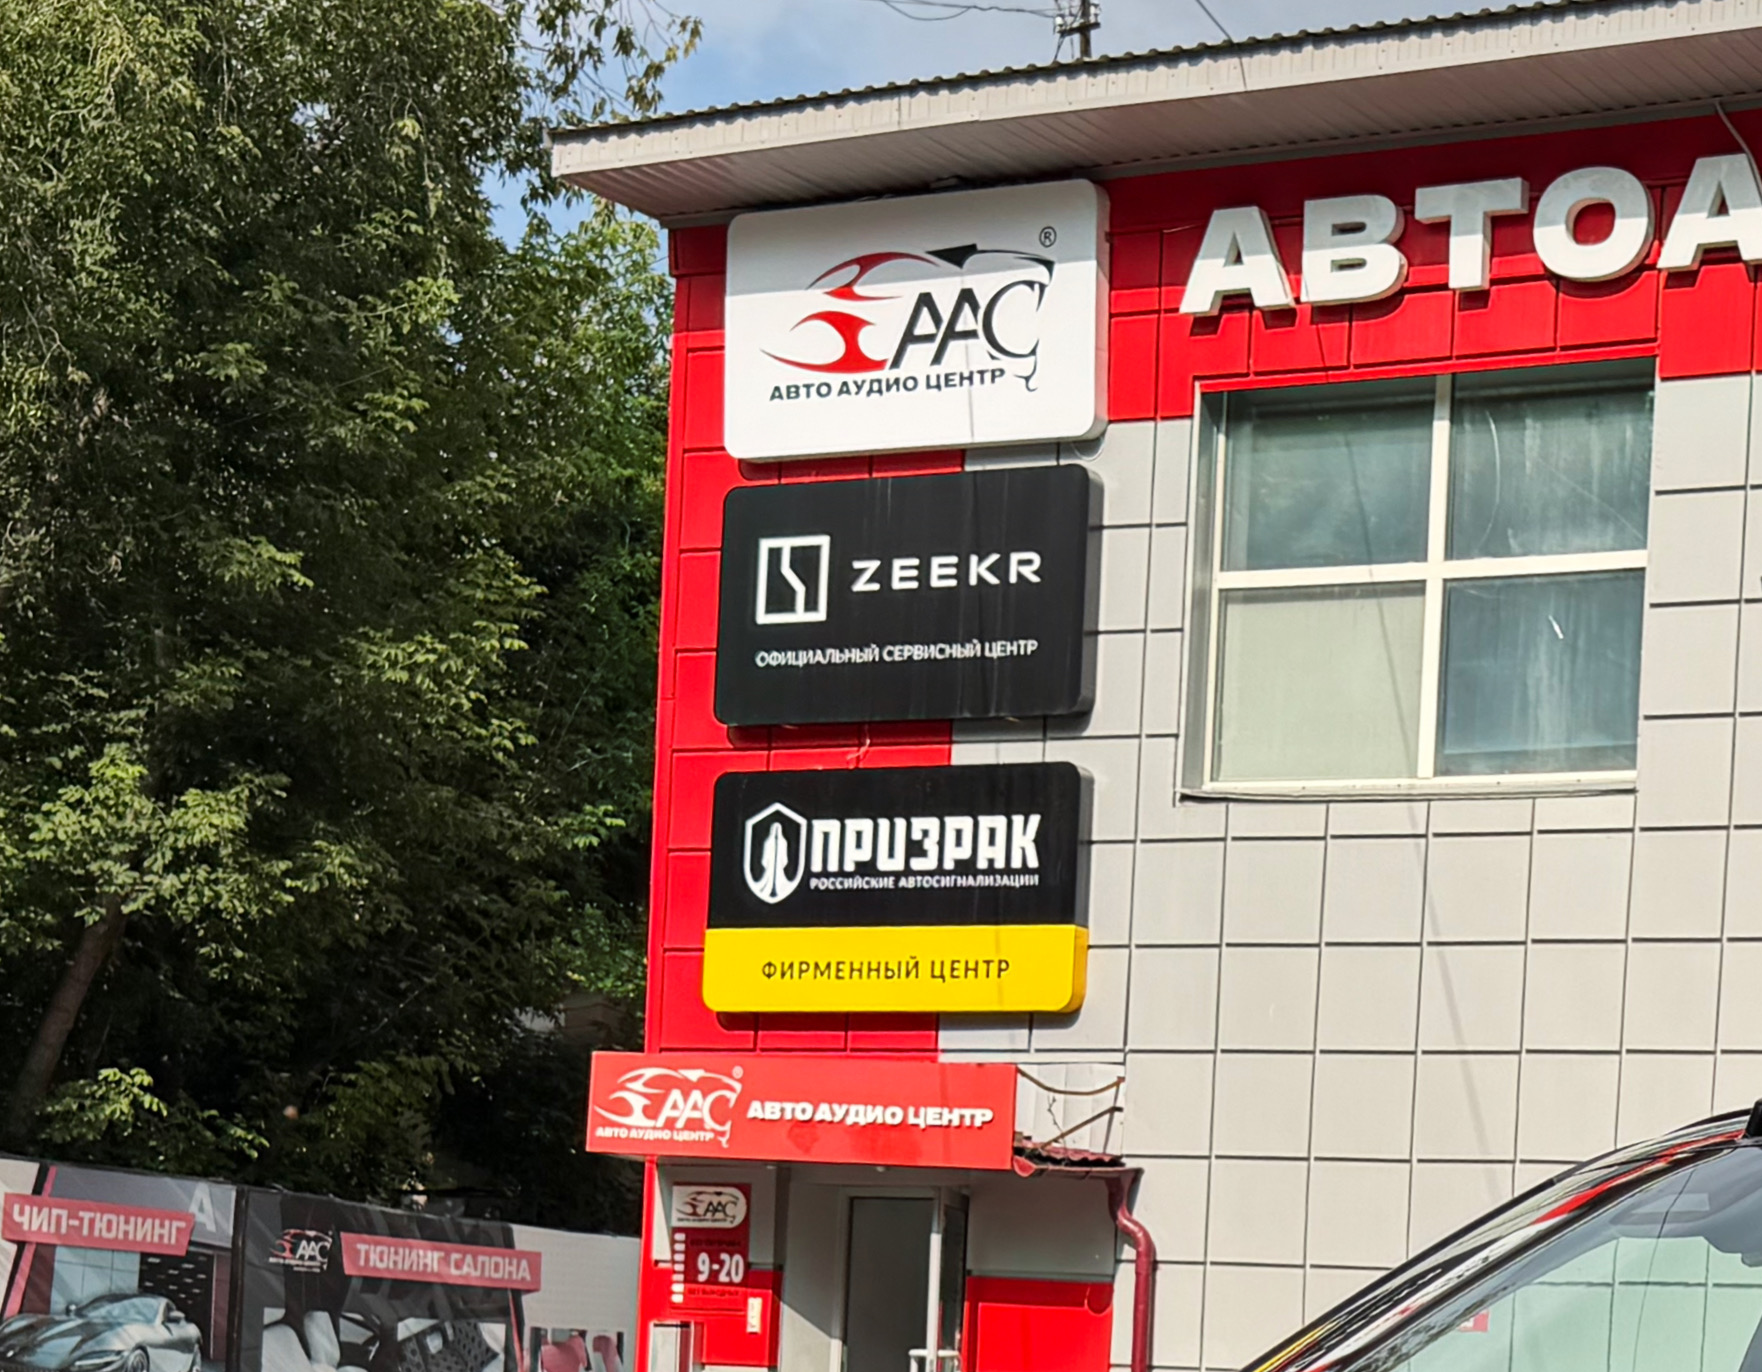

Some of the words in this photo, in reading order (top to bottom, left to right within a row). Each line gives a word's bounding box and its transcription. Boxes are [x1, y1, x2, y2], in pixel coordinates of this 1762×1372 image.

[769, 382, 833, 402] АВТО
[836, 374, 919, 398] АУДИО
[925, 367, 1006, 393] ЦЕНТР
[851, 551, 1043, 593] ZEEKR
[755, 644, 879, 668] ОФИЦИАЛЬНЫЙ
[882, 640, 982, 664] СЕРВИСНЫЙ
[984, 639, 1039, 661] ЦЕНТР
[810, 813, 1042, 874] ПРИЗРАК
[809, 874, 896, 891] РОССИЙСКИЕ
[899, 873, 1040, 890] АВТОСИГНАЛИЗАЦИИ
[761, 955, 920, 981] ФИРМЕННЫЙ
[930, 958, 1011, 984] ЦЕНТР
[747, 1100, 813, 1122] АВТО
[813, 1102, 904, 1127] АУДИО
[907, 1106, 994, 1129] ЦЕНТР
[595, 1127, 628, 1139] АВТО
[629, 1127, 671, 1141] АУДИО
[672, 1130, 715, 1142] ЦЕНТР
[12, 1203, 187, 1245] ЧИП-ТЮНИНГ
[356, 1243, 445, 1272] ТЮНИНГ
[449, 1252, 532, 1282] САЛОНА
[697, 1252, 745, 1284] 9-20
